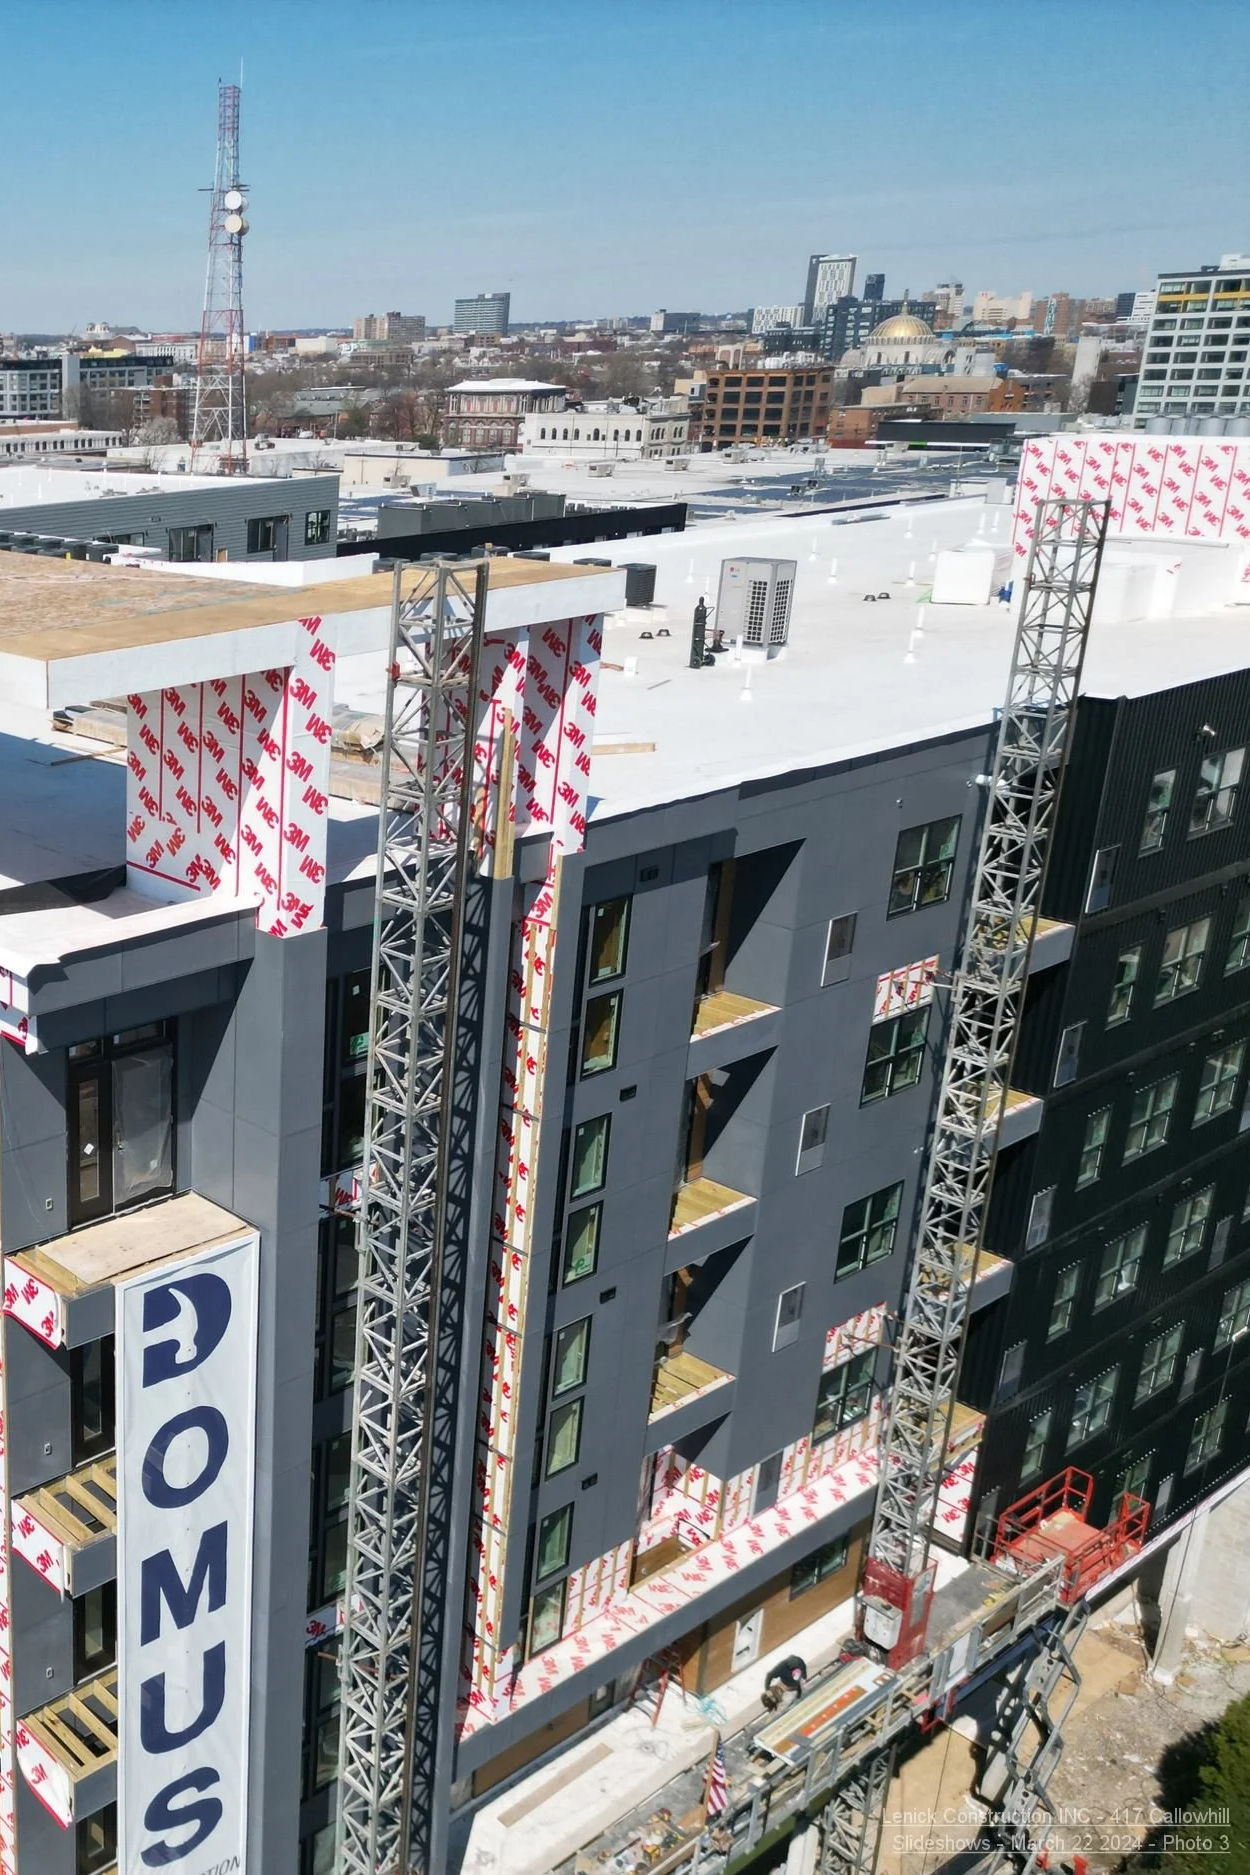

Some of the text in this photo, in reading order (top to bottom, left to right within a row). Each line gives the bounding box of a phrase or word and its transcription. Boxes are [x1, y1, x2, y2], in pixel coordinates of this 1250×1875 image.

[310, 638, 335, 671] 3M
[504, 642, 525, 672] 3M
[542, 628, 566, 657] 3M
[527, 655, 547, 685] 3M
[569, 661, 591, 688] 3M
[129, 695, 147, 719] 3M
[165, 687, 186, 717] 3M
[244, 689, 267, 723] 3M
[289, 678, 318, 710] 3M
[537, 683, 561, 709] 3M
[217, 701, 240, 734] 3M
[305, 714, 332, 744] 3M
[523, 706, 542, 735] 3M
[139, 724, 159, 755] 3M
[177, 721, 198, 753] 3M
[203, 731, 225, 763] 3M
[257, 728, 281, 762] 3M
[564, 721, 585, 748] 3M
[127, 751, 146, 781] 3M
[164, 749, 185, 780] 3M
[286, 751, 314, 782] 3M
[531, 739, 555, 768] 3M
[216, 768, 238, 800] 3M
[242, 758, 265, 791] 3M
[518, 764, 537, 793] 3M
[138, 786, 158, 816] 3M
[176, 785, 197, 816] 3M
[302, 785, 328, 815] 3M
[558, 781, 580, 808] 3M
[202, 795, 223, 828] 3M
[256, 796, 279, 829] 3M
[526, 797, 549, 823] 3M
[127, 815, 145, 842] 3M
[166, 827, 185, 856] 3M
[241, 824, 263, 856] 3M
[284, 823, 310, 853] 3M
[146, 840, 164, 869] 3M
[214, 832, 236, 864] 3M
[186, 854, 202, 883] 3M
[199, 858, 221, 890] 3M
[255, 863, 277, 895] 3M
[299, 855, 326, 884] 3M
[532, 892, 552, 918] 3M
[140, 1271, 232, 1869] DOMUS
